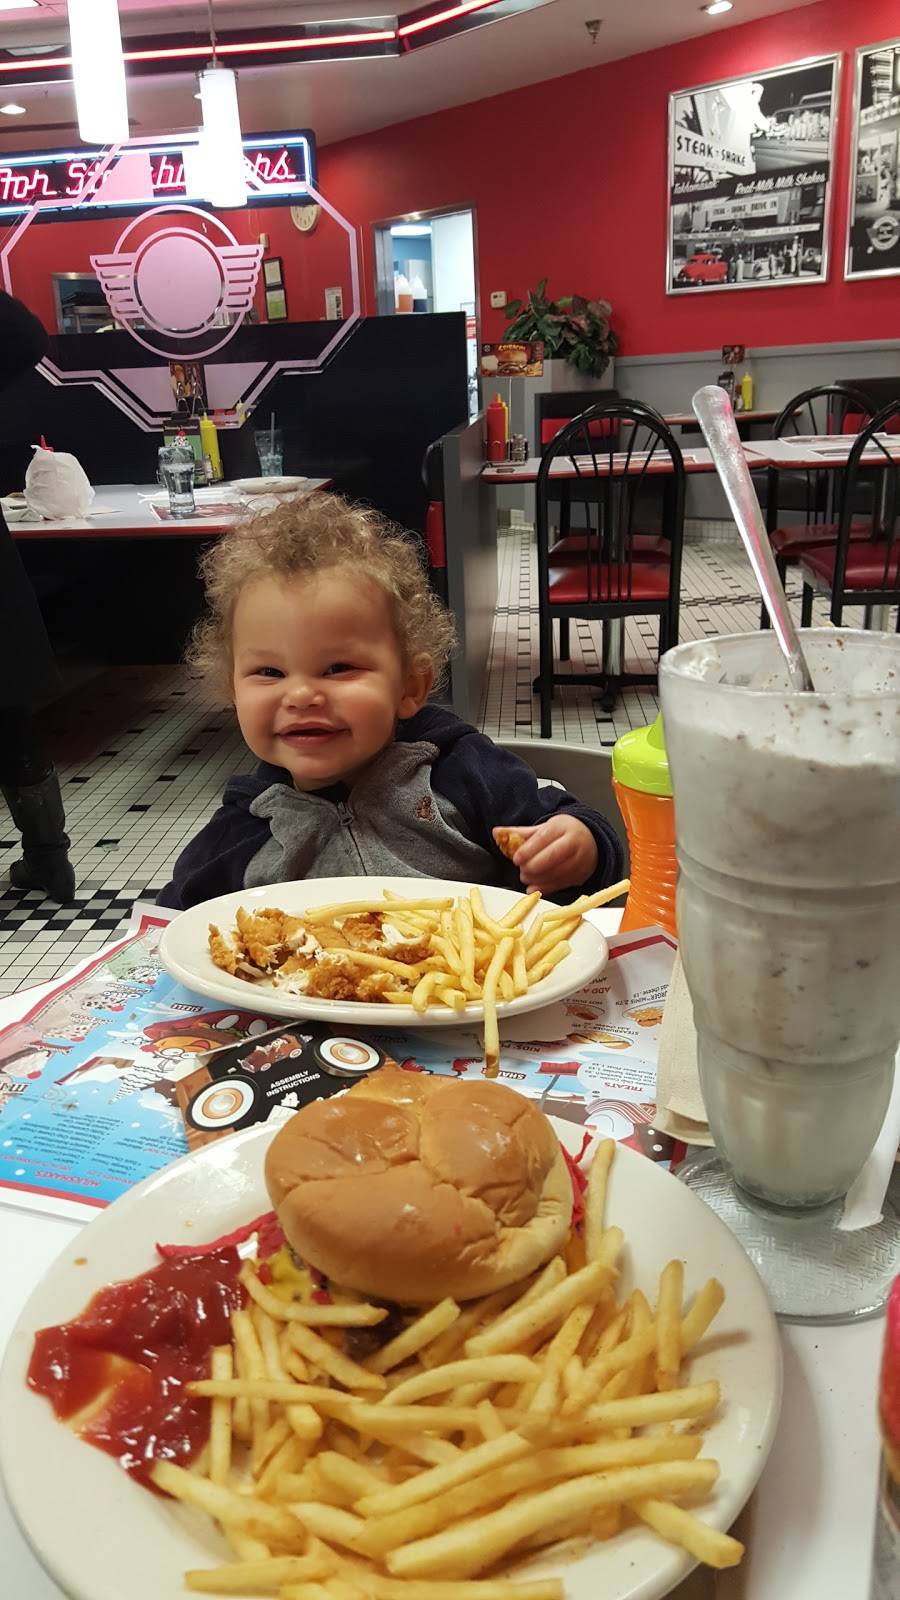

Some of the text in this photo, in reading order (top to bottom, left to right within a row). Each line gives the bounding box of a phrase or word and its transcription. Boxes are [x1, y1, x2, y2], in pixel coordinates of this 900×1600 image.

[676, 135, 714, 158] STEAK
[721, 149, 746, 167] SHAKE
[266, 1073, 321, 1097] INSTRUCTIONS
[270, 1070, 309, 1089] ASSEMBLY
[604, 1082, 643, 1092] TREATS
